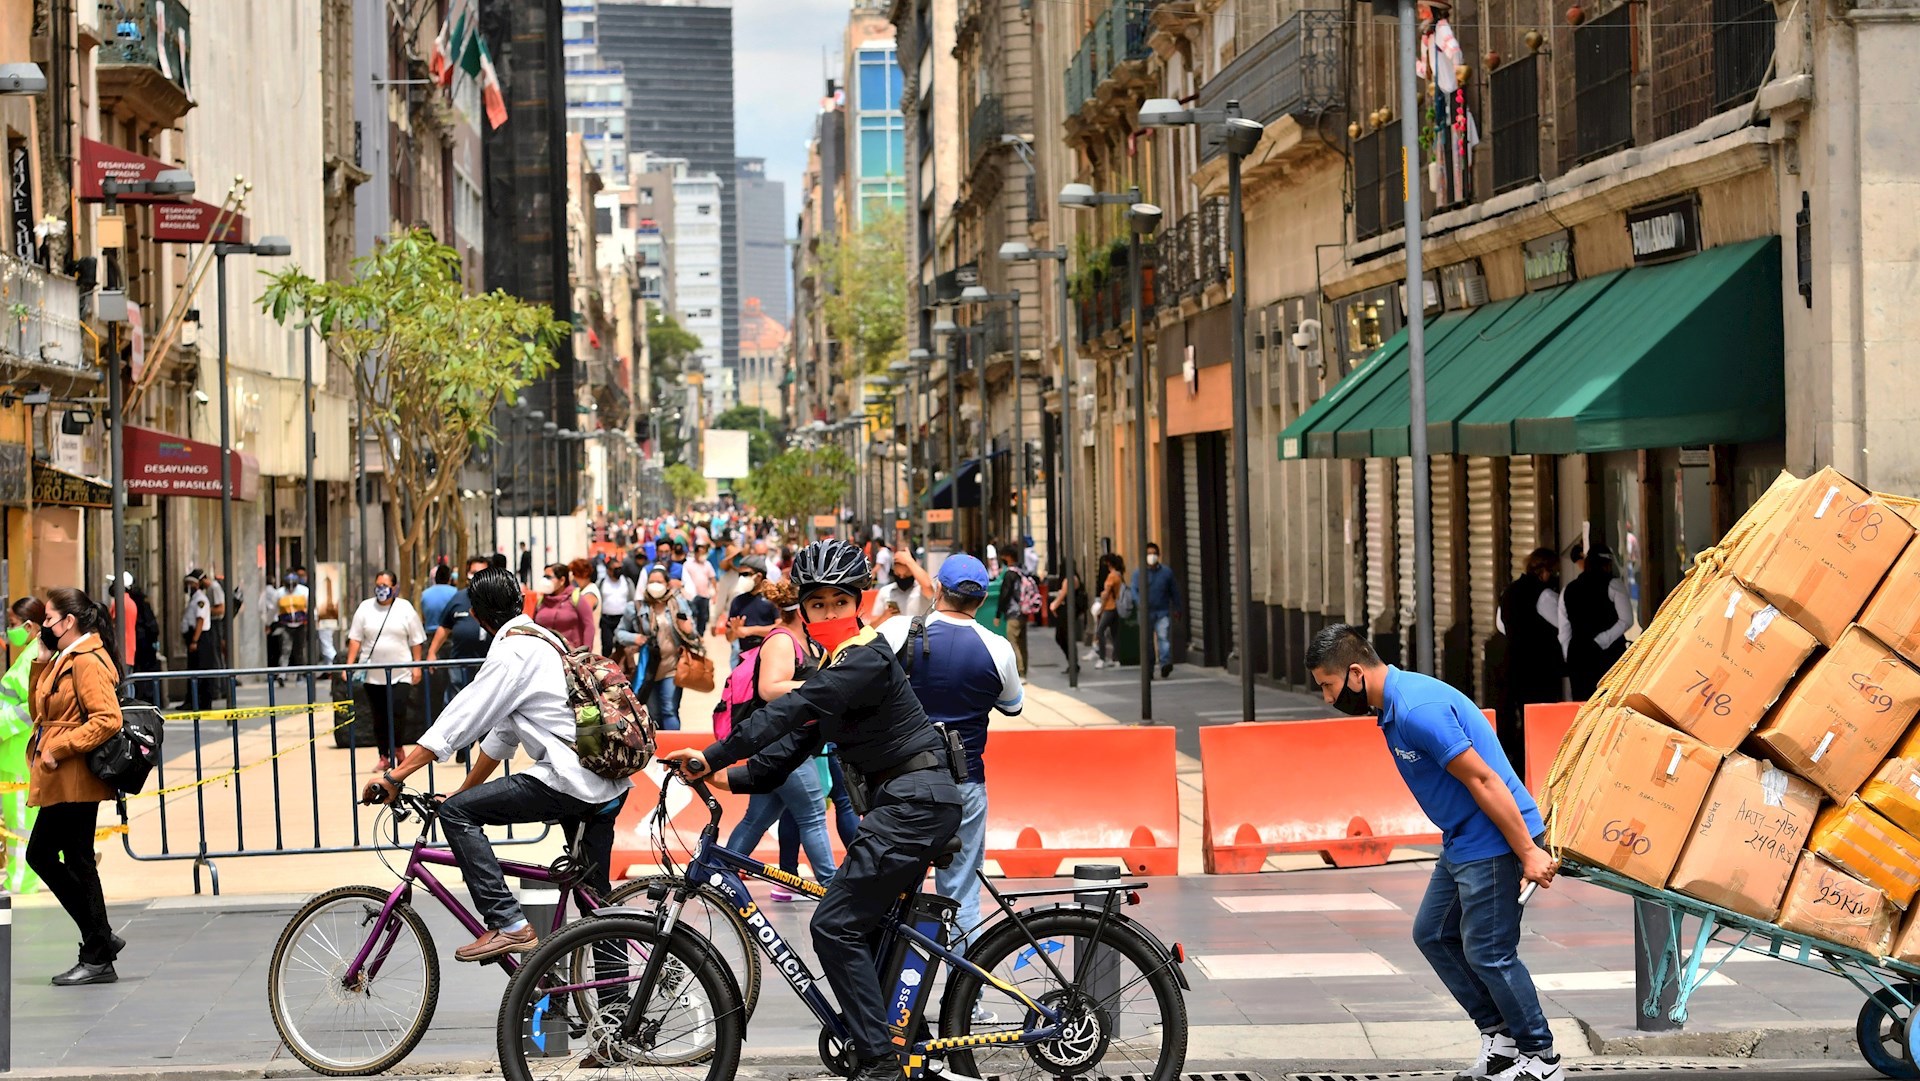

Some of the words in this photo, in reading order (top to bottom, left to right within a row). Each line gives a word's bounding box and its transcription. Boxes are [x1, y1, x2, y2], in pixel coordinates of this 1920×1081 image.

[97, 161, 146, 170] DESAYUNOS
[144, 464, 209, 475] DESAYUNOS
[33, 484, 62, 501] ORO
[123, 479, 169, 489] ESPADAS
[1838, 496, 1882, 541] 708
[1686, 670, 1731, 716] 748
[763, 864, 802, 887] TRANSITO
[720, 883, 736, 897] SSC
[739, 902, 757, 918] 3
[896, 988, 911, 1009] SSC
[896, 1008, 911, 1027] 3
